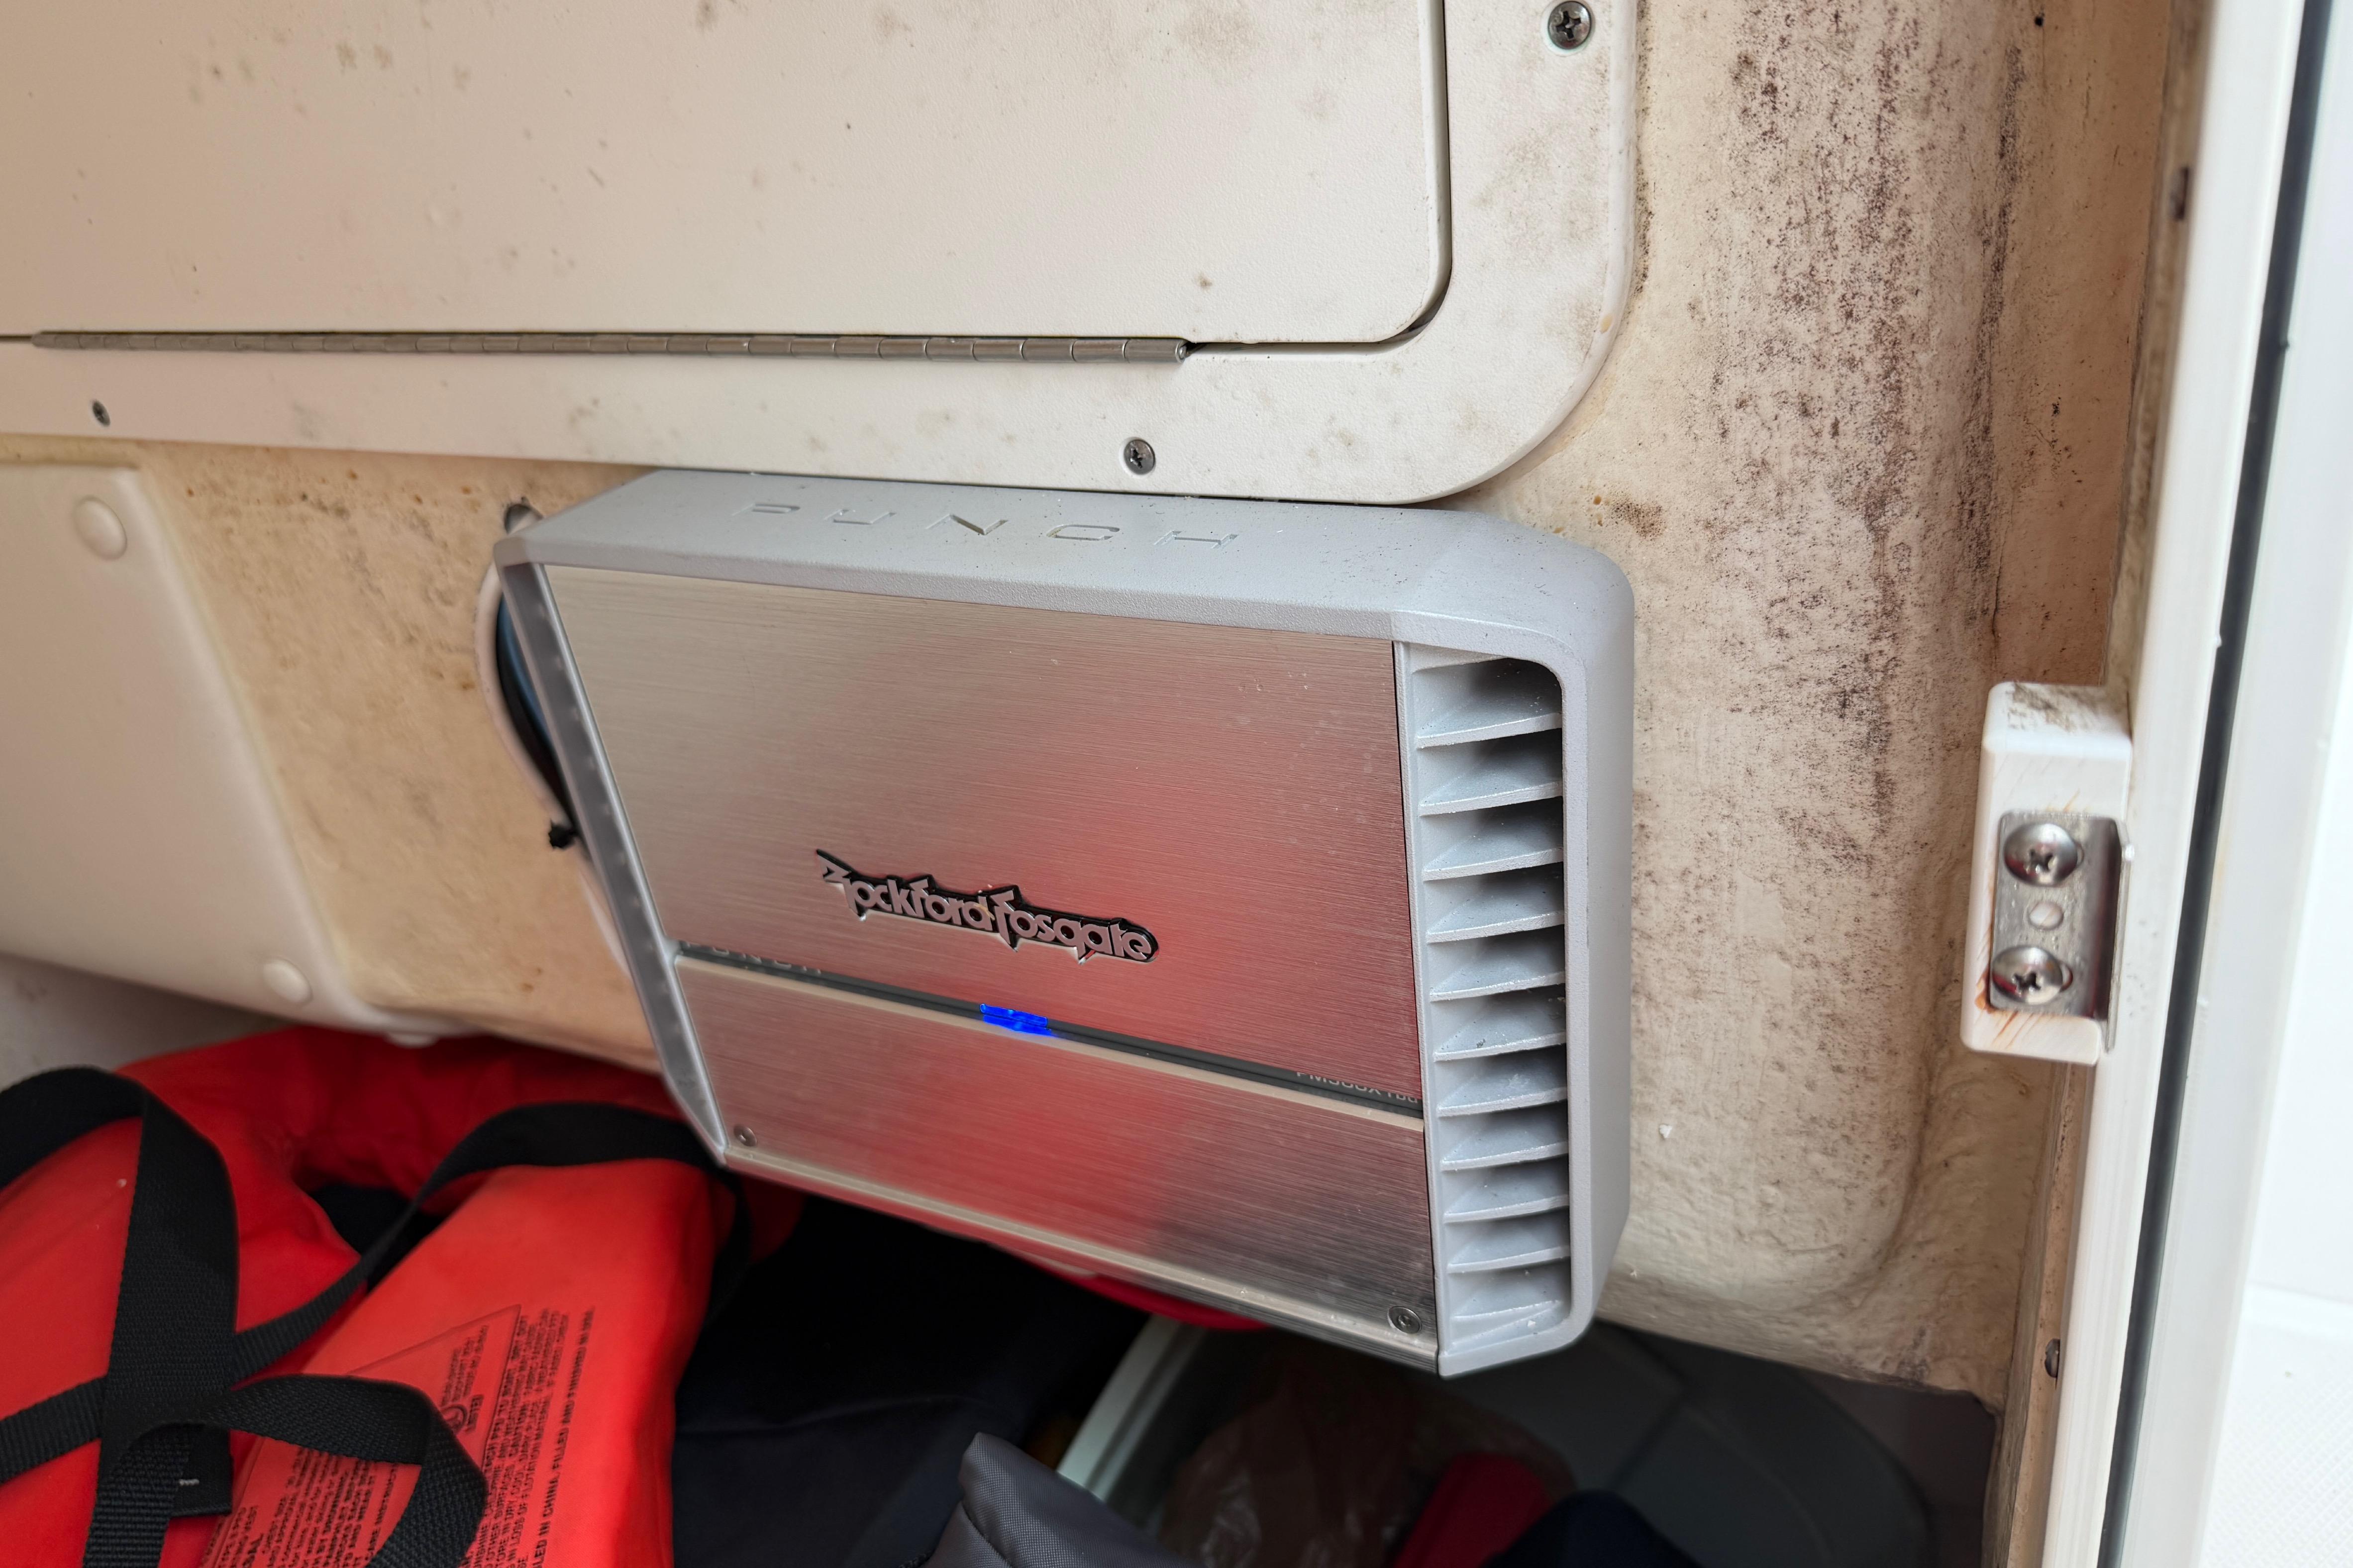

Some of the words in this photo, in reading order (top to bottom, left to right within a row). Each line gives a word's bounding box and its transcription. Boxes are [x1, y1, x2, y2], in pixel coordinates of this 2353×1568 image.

[731, 502, 1240, 550] PUNCH
[816, 848, 995, 932] Rockford
[989, 884, 1160, 964] Fosgate
